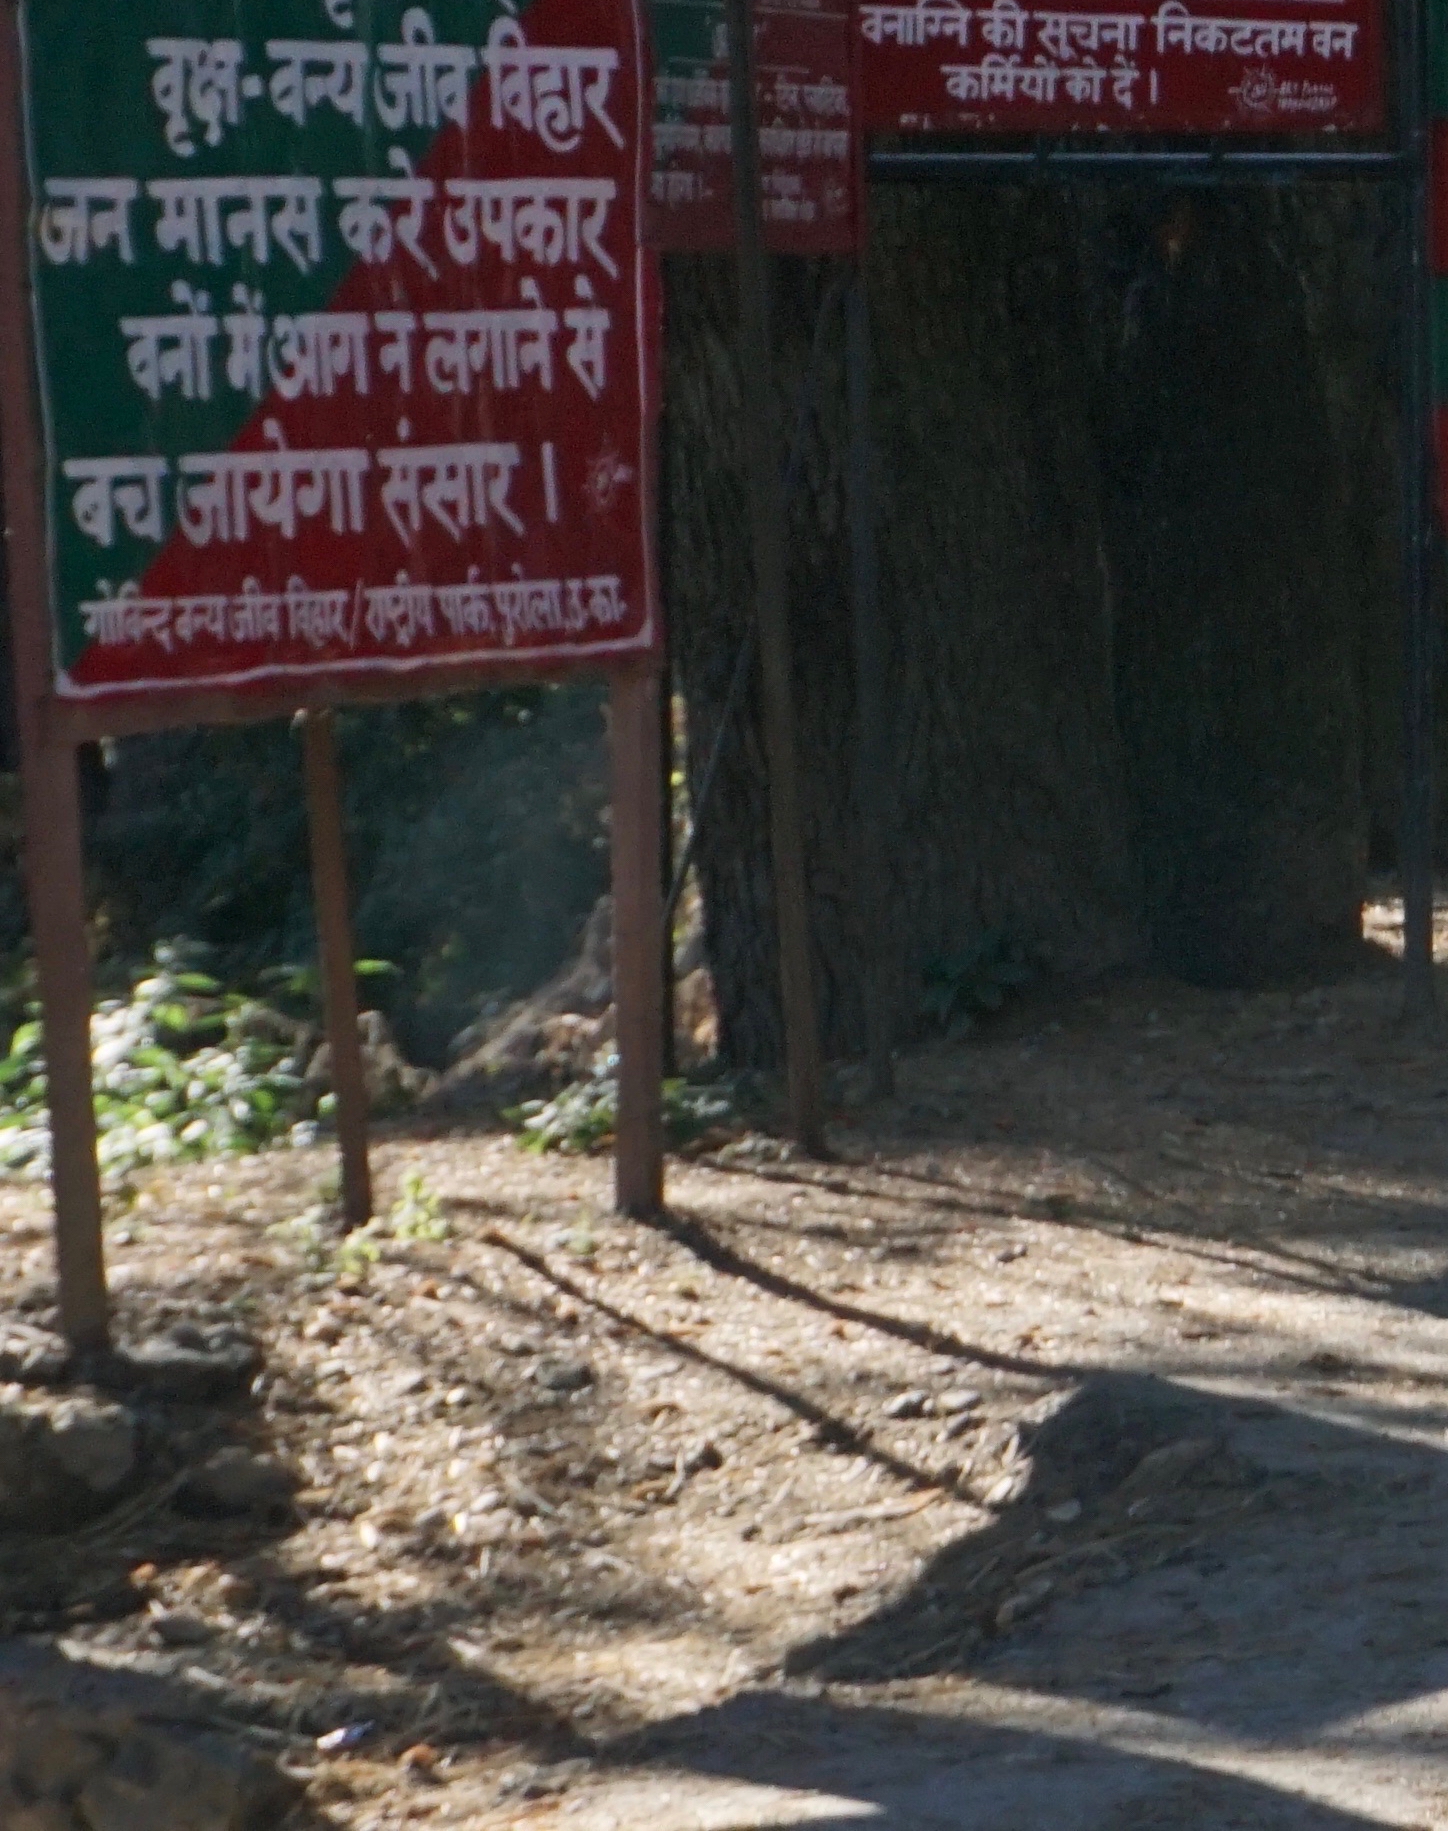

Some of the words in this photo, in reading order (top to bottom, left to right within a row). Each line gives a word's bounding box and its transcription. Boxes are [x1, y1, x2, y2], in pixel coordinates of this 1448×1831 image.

[373, 6, 477, 129] जीव
[482, 13, 626, 153] विहार
[1034, 5, 1145, 60] सूचना
[1152, 0, 1309, 60] निकटतम
[1309, 19, 1359, 62] वन
[1060, 54, 1107, 103] को
[40, 177, 137, 265] जन
[146, 176, 323, 275] मानस
[333, 146, 439, 279] करे
[443, 177, 619, 279] उपकार
[119, 278, 219, 401] वनों
[223, 280, 267, 401] में
[268, 310, 370, 401] आग
[375, 311, 416, 394] न
[423, 276, 560, 395] लगाने
[562, 274, 611, 405] से
[63, 455, 168, 548] बच
[175, 416, 371, 543] जायेगा
[376, 418, 525, 550] संसार
[173, 593, 228, 645] वन्य
[229, 574, 284, 643] जीव
